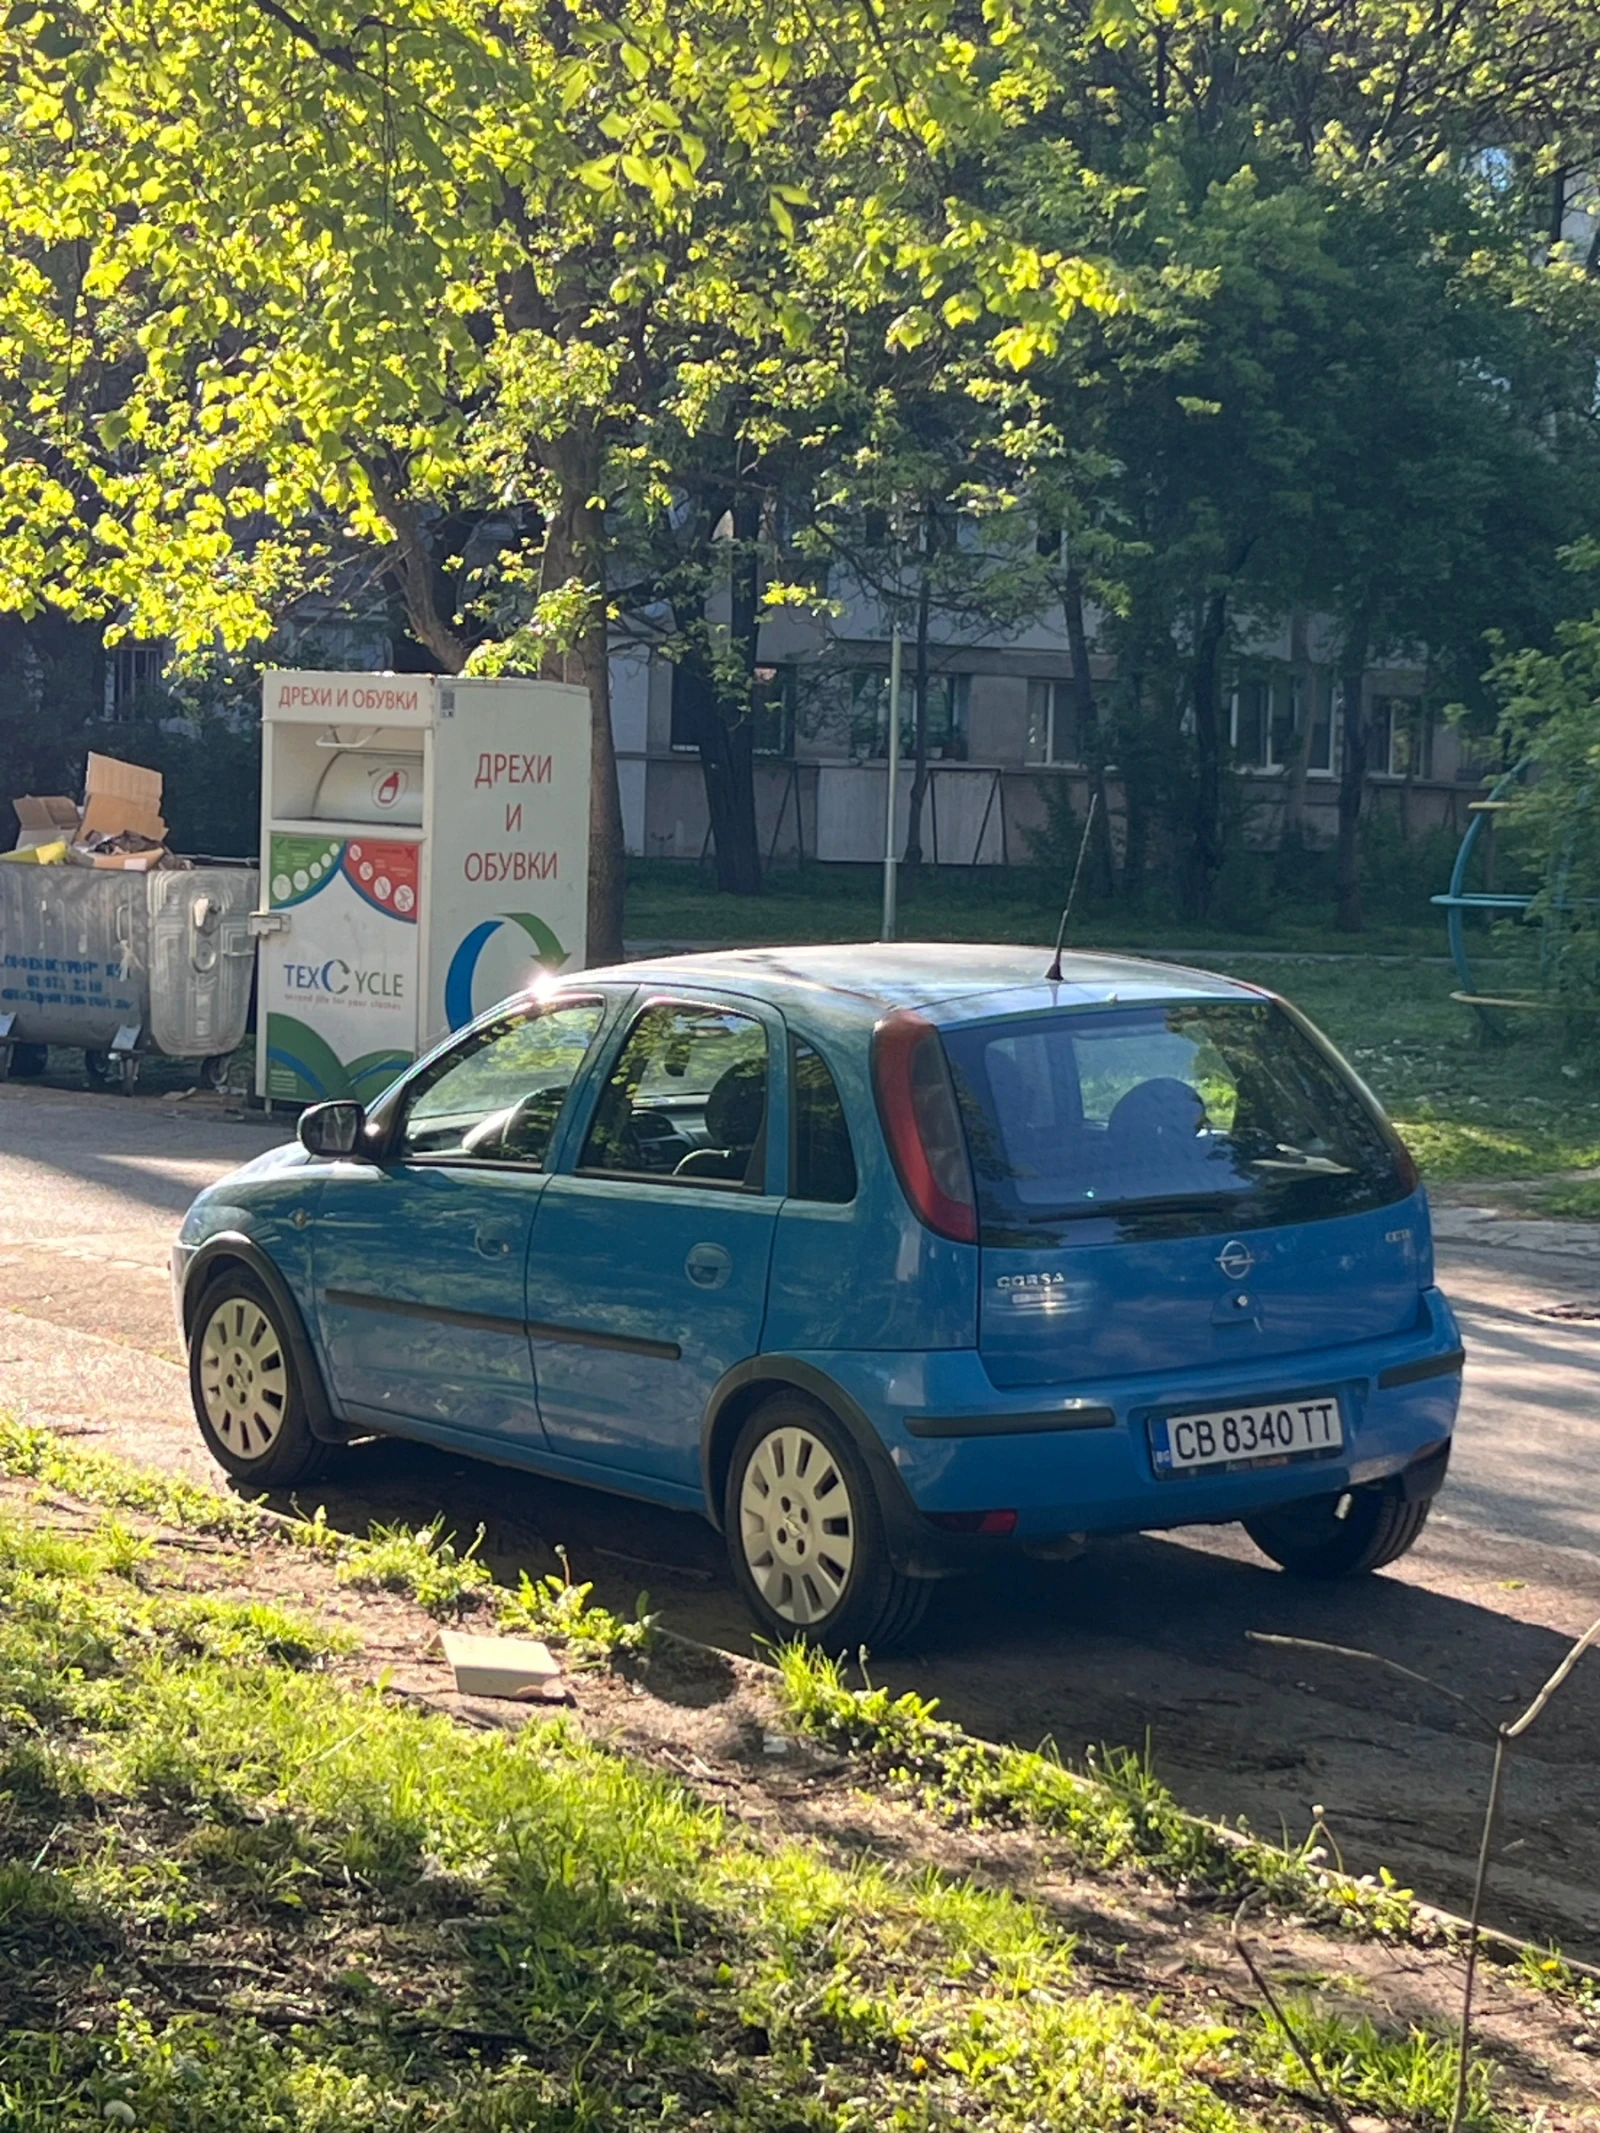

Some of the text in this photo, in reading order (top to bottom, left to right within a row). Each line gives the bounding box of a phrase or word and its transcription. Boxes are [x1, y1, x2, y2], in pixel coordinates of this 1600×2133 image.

[278, 685, 418, 711] ДРЕХИ И ОБУВКИ
[474, 753, 552, 789] ДРЕХИ
[506, 803, 522, 832] И
[464, 851, 558, 882] ОБУВКИ
[996, 1271, 1065, 1288] CORSA
[1174, 1403, 1333, 1460] CB 8340 TT
